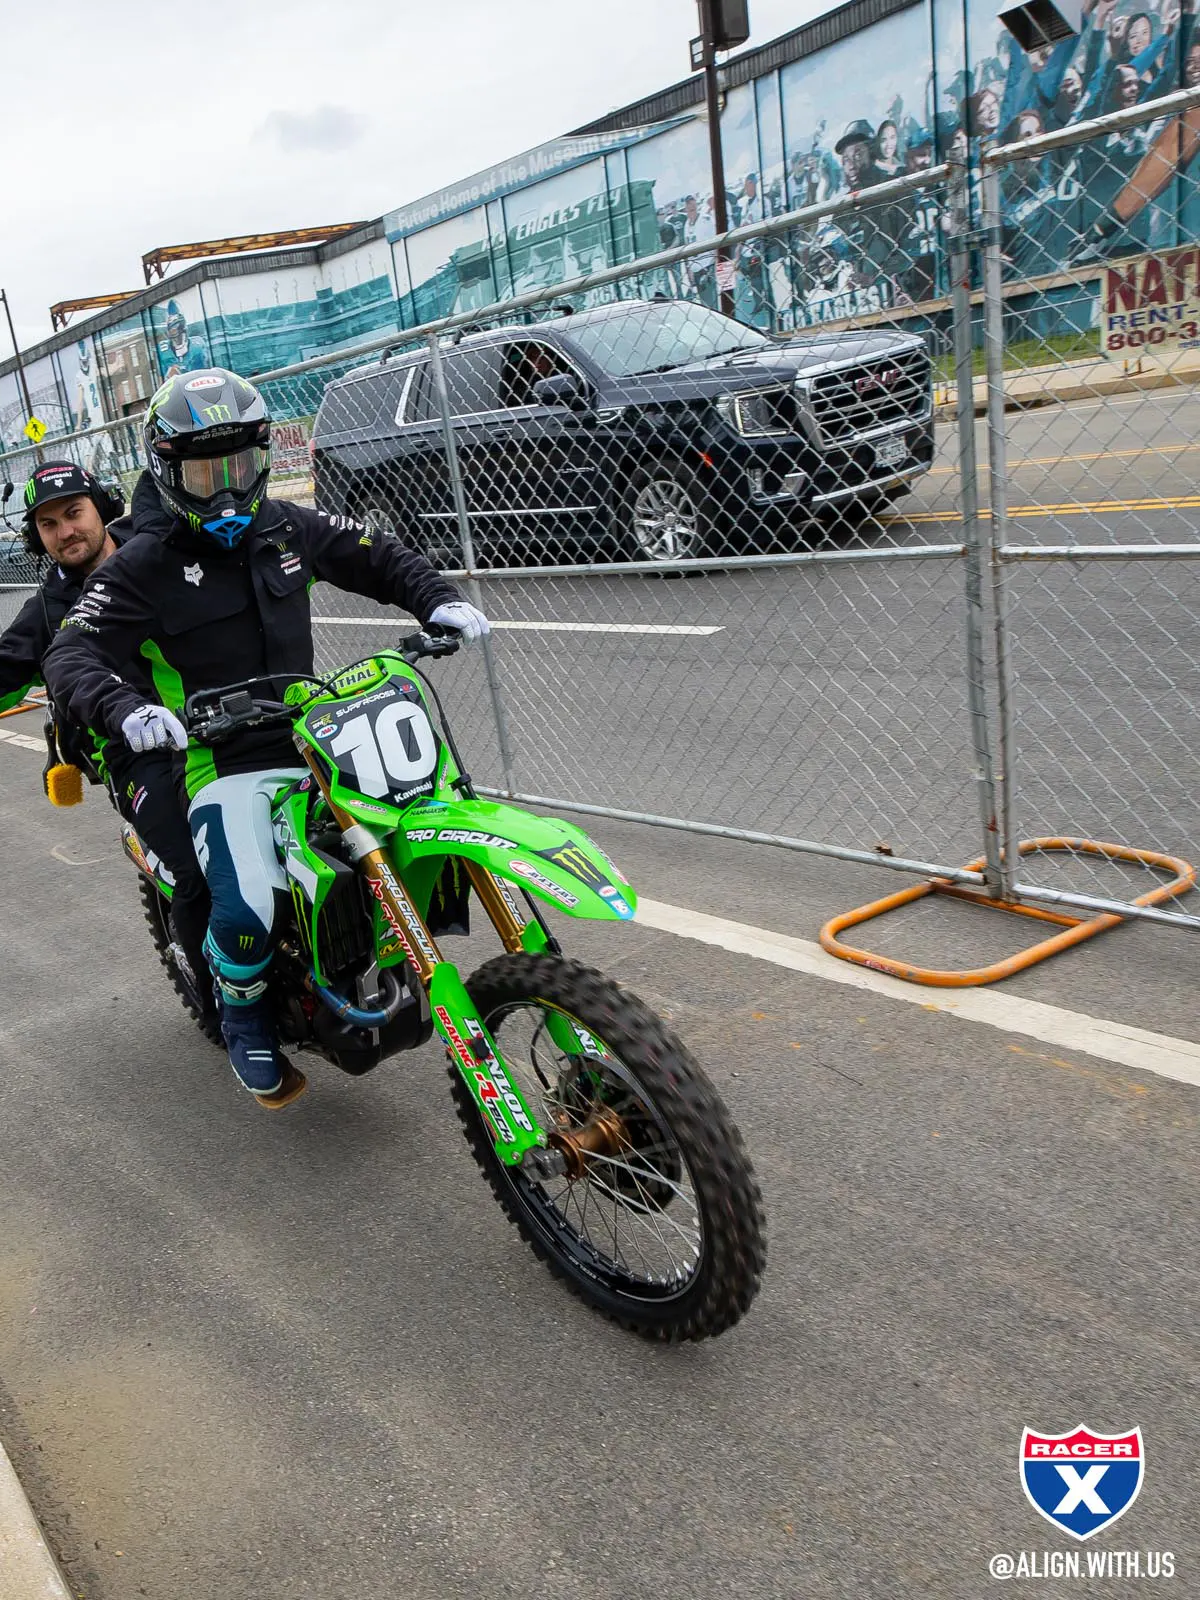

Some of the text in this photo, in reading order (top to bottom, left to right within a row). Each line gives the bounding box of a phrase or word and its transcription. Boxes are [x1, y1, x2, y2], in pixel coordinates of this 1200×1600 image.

[397, 201, 440, 229] Future
[440, 186, 481, 216] Home
[483, 180, 498, 199] of
[499, 165, 527, 189] The
[516, 203, 580, 241] EAGLES
[587, 188, 621, 214] FLY
[1107, 249, 1200, 314] NAT
[191, 377, 220, 388] BELL
[211, 427, 244, 438] CIRCUIT
[330, 701, 437, 799] 10
[394, 781, 433, 803] Kawasaki
[406, 828, 519, 850] PRO CIRCUIT
[376, 863, 439, 964] PRO CIRCUIT
[434, 1006, 477, 1069] BRAKING
[462, 1016, 535, 1132] DNLOP
